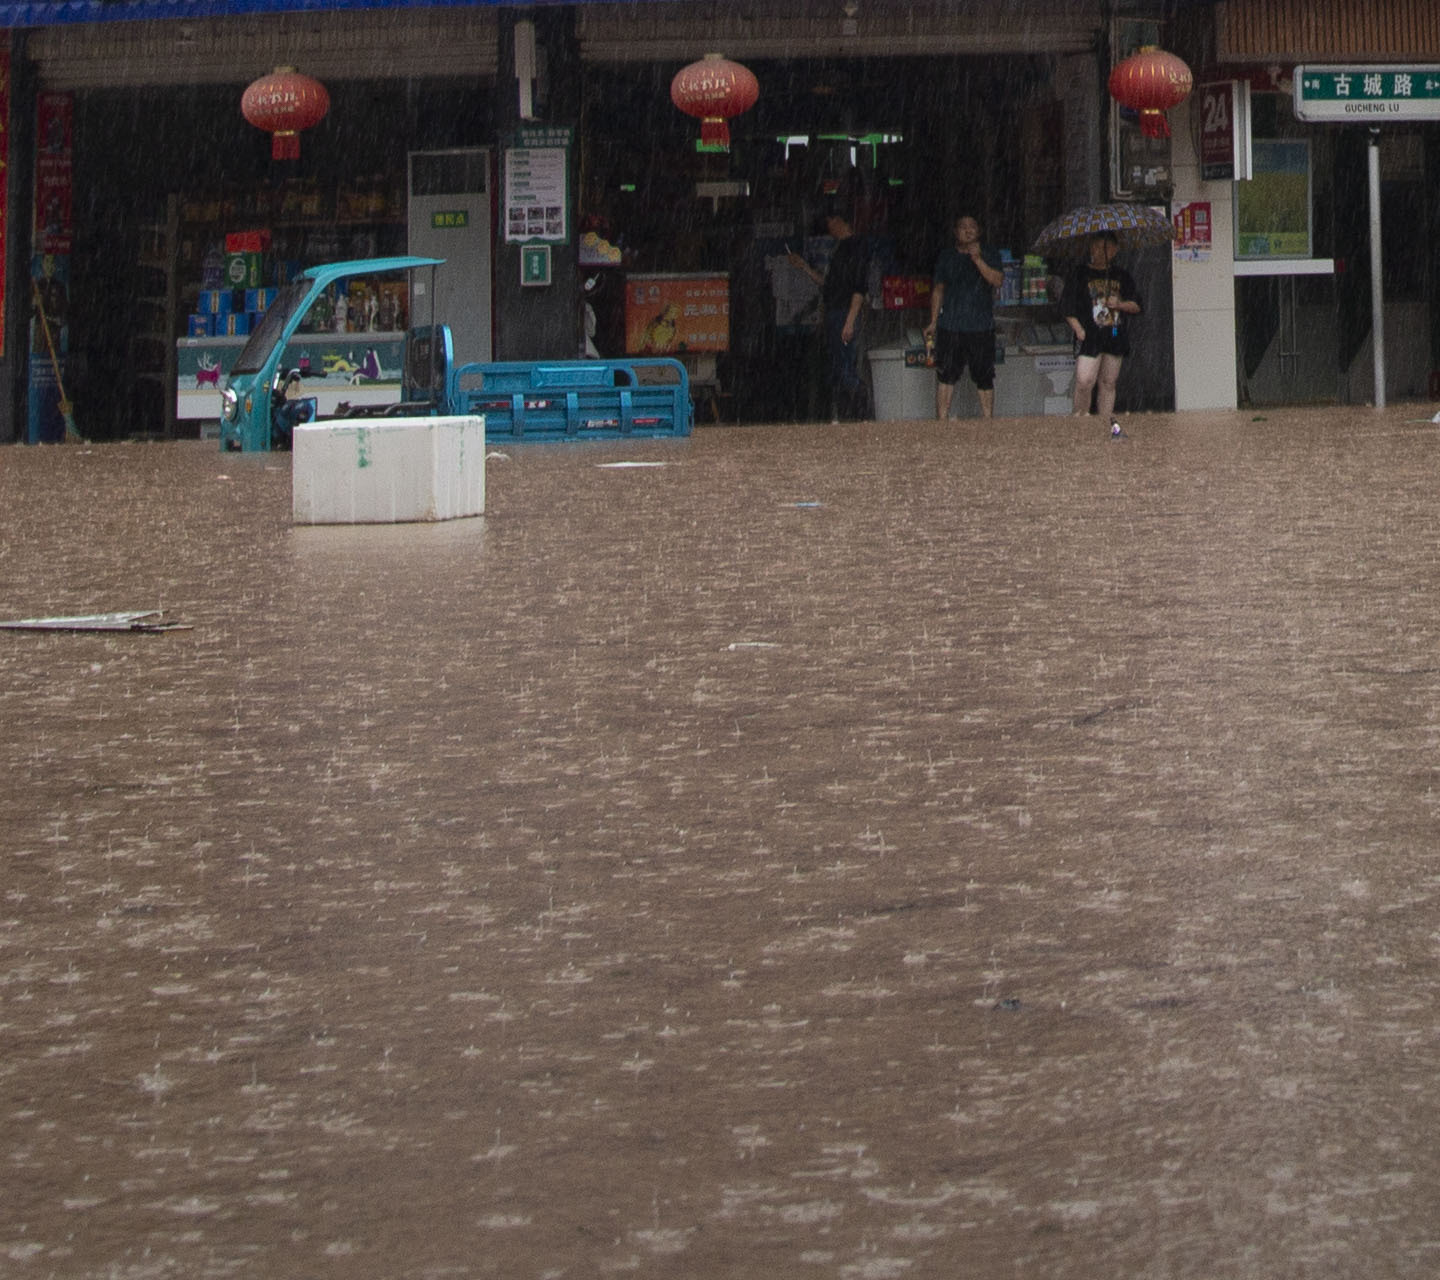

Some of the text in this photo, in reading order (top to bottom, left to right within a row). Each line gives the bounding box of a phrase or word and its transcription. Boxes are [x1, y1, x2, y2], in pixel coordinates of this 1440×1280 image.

[1333, 73, 1413, 97] 古城路
[1203, 92, 1229, 133] 24
[1344, 102, 1400, 113] GUCHENG LU
